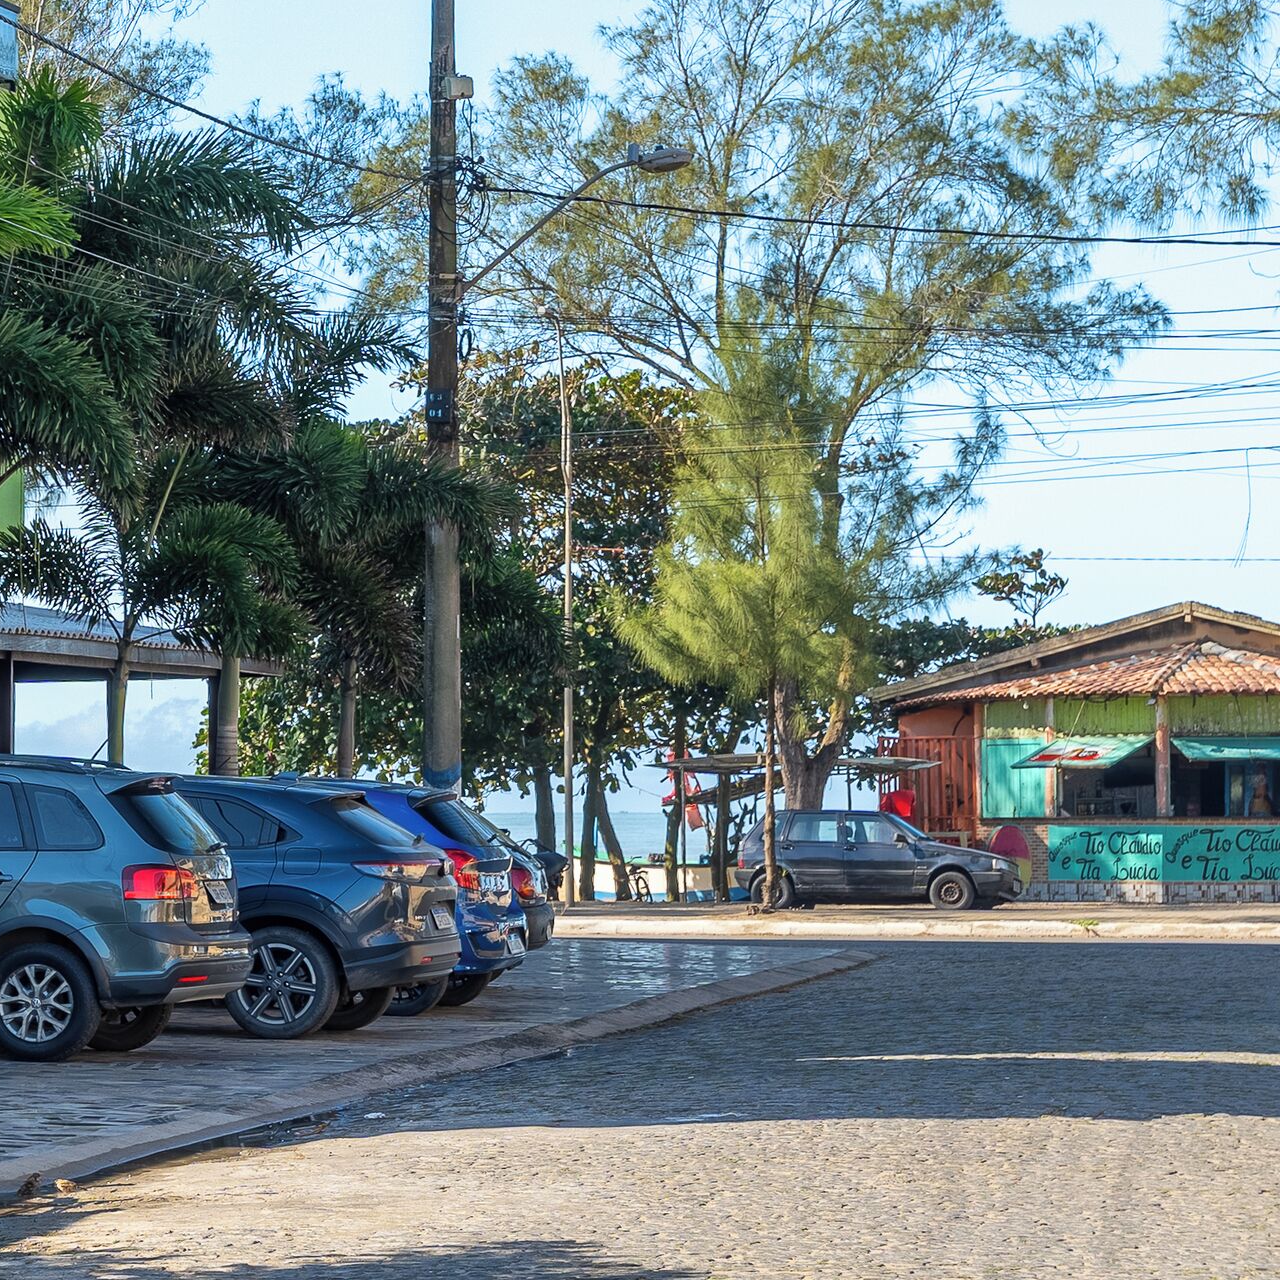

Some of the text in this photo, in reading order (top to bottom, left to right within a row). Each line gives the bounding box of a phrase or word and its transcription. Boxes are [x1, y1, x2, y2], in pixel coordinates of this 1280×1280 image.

[1080, 831, 1104, 855] Tio
[1108, 831, 1161, 855] Cláudio
[1199, 828, 1233, 852] Tio
[1236, 828, 1280, 852] Cláu
[1061, 856, 1160, 880] e Tia Lúcia
[1181, 855, 1192, 869] e
[1197, 855, 1231, 881] Tia
